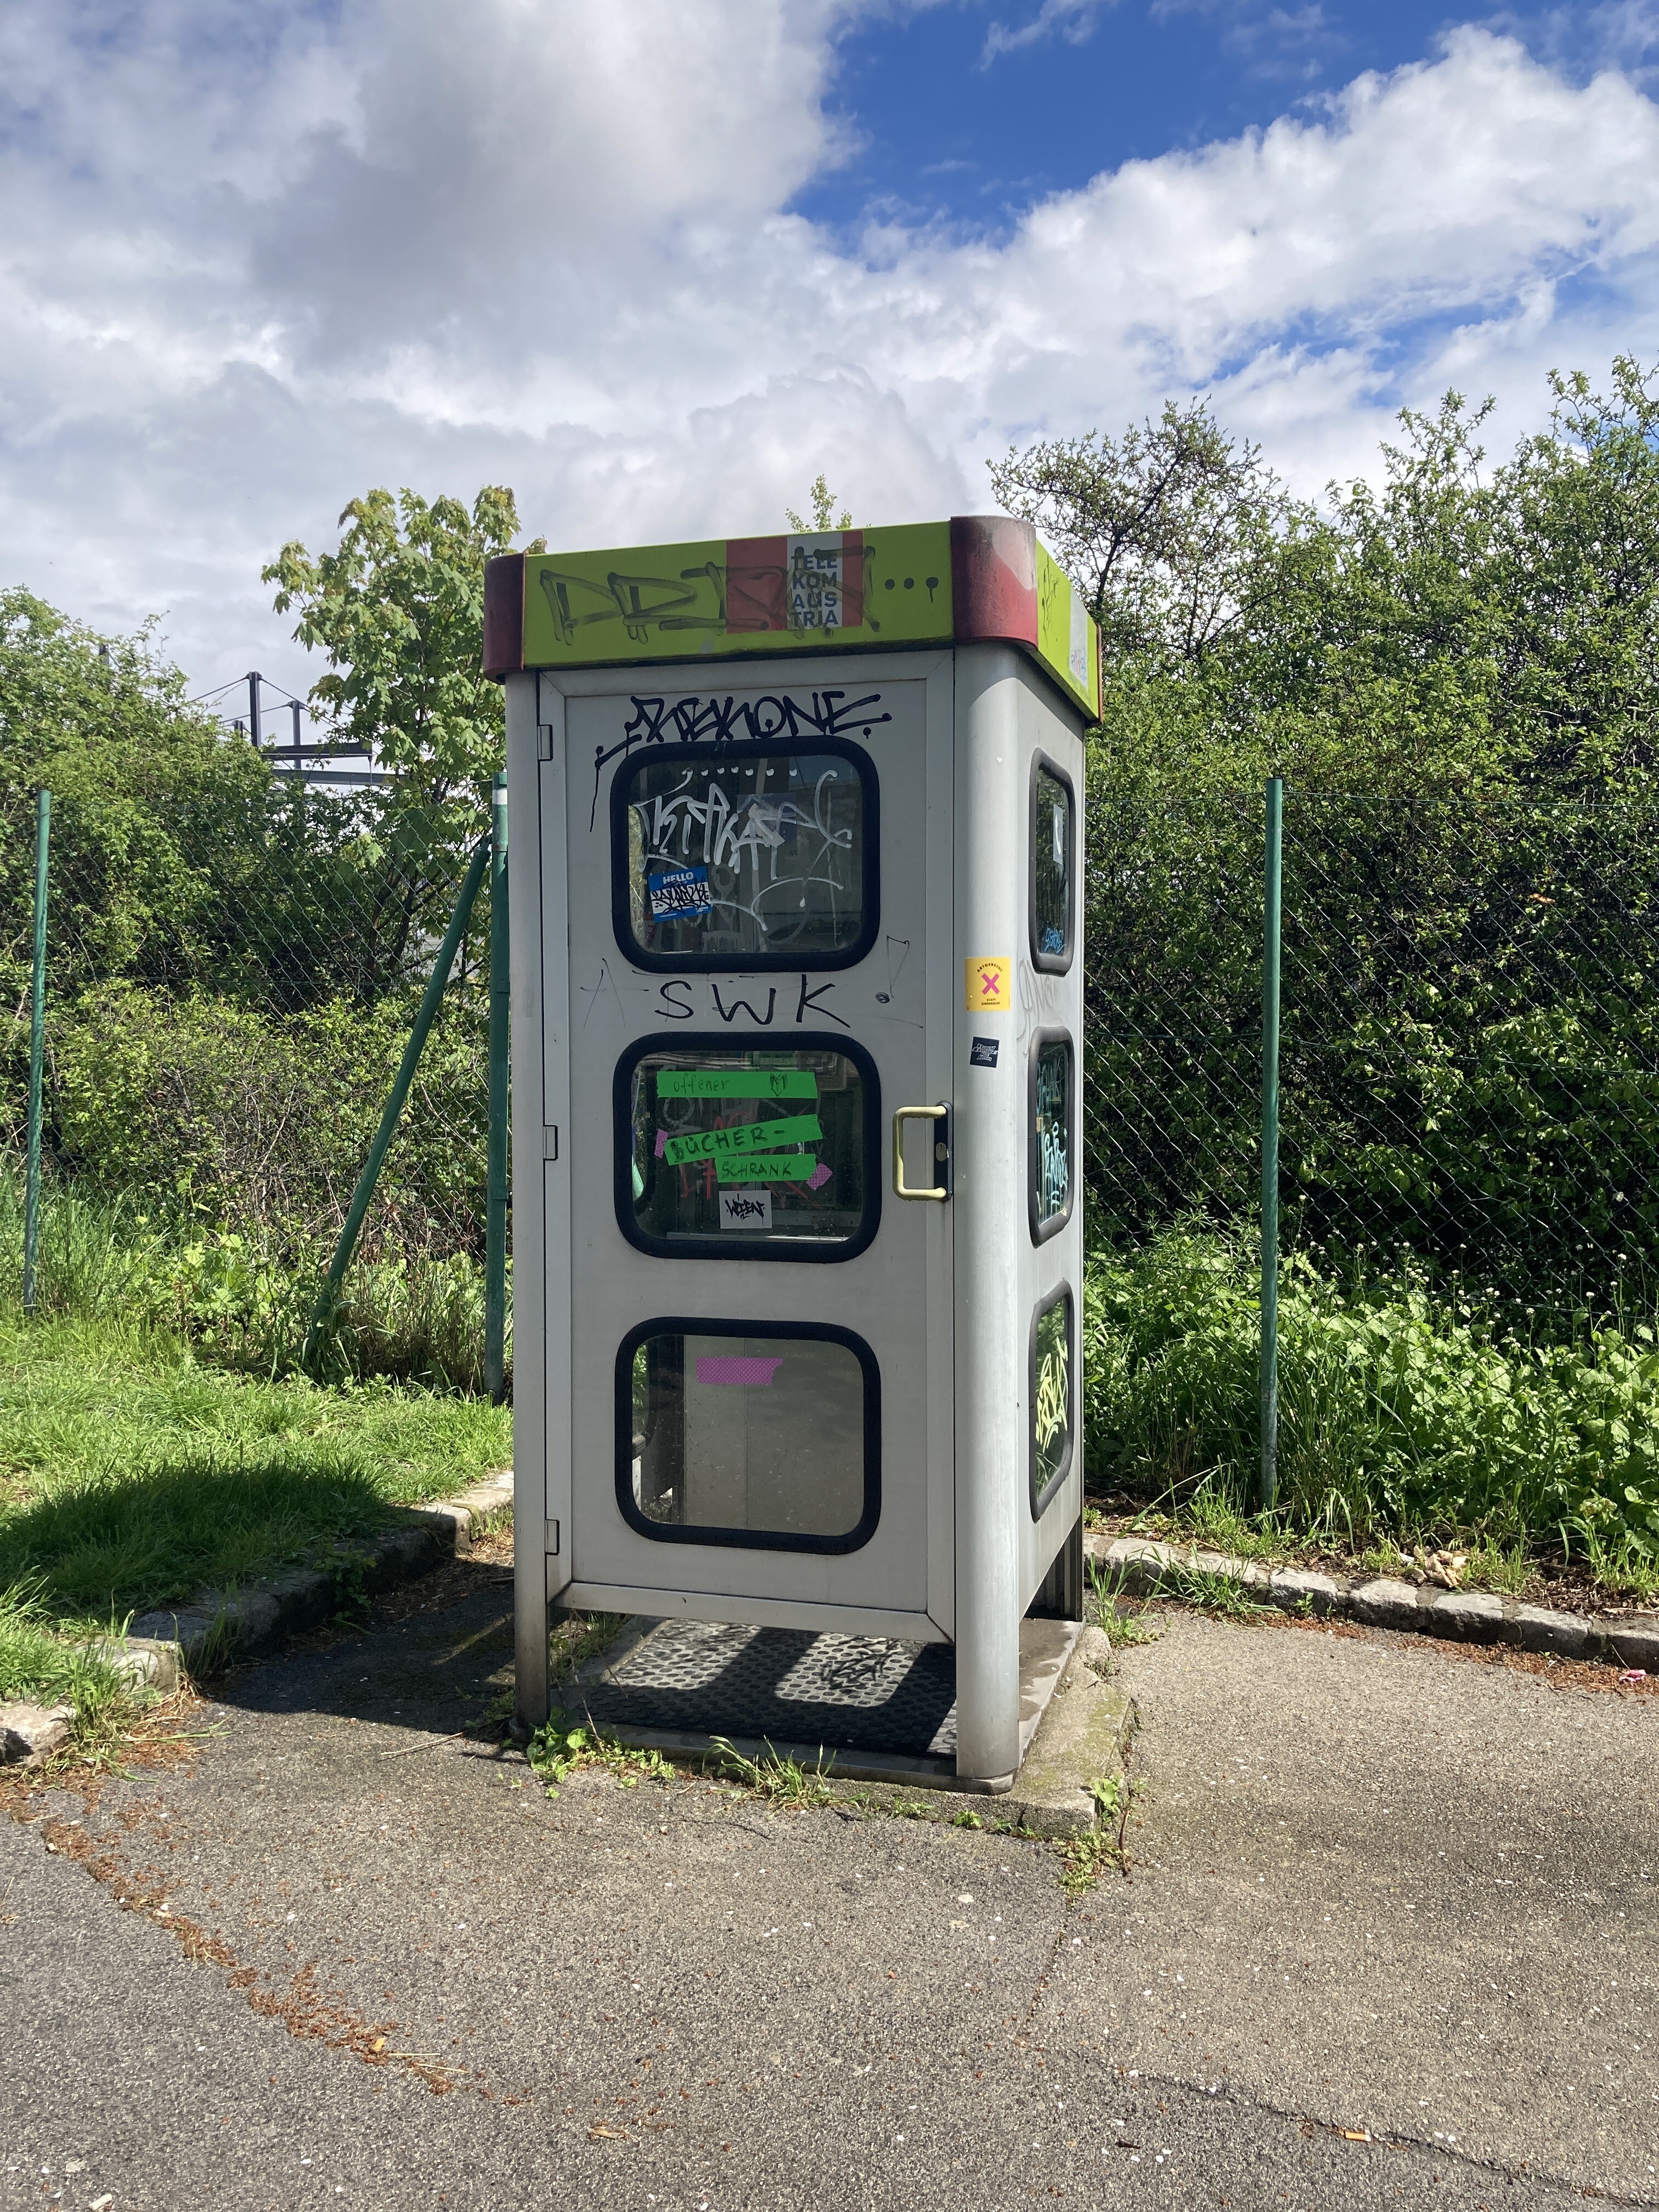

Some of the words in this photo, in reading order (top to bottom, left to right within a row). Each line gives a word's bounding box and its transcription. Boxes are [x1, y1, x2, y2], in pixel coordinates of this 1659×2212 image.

[791, 554, 838, 570] TELE
[792, 571, 838, 590] KOM
[792, 591, 838, 609] AUS
[791, 609, 839, 627] TRIA
[663, 872, 694, 884] HELLO
[654, 974, 851, 1028] SWK
[673, 1073, 730, 1094] offener
[721, 1160, 792, 1180] SCHRANK
